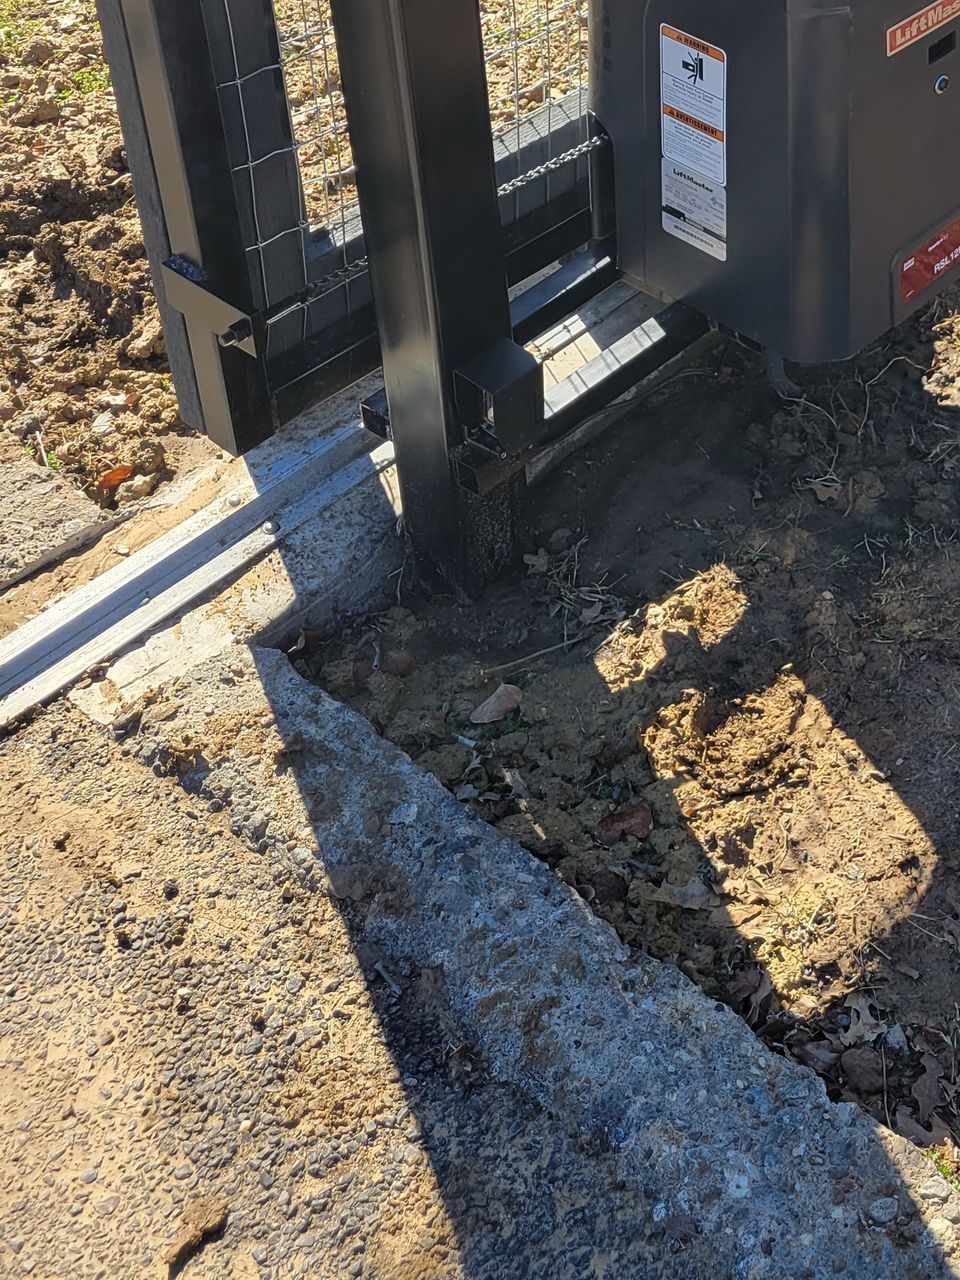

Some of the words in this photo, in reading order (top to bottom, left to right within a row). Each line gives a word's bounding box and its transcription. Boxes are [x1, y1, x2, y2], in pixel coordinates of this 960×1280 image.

[683, 37, 710, 54] WARNING
[675, 112, 718, 137] AVERTISSEMENT
[673, 168, 714, 193] LiftMaster
